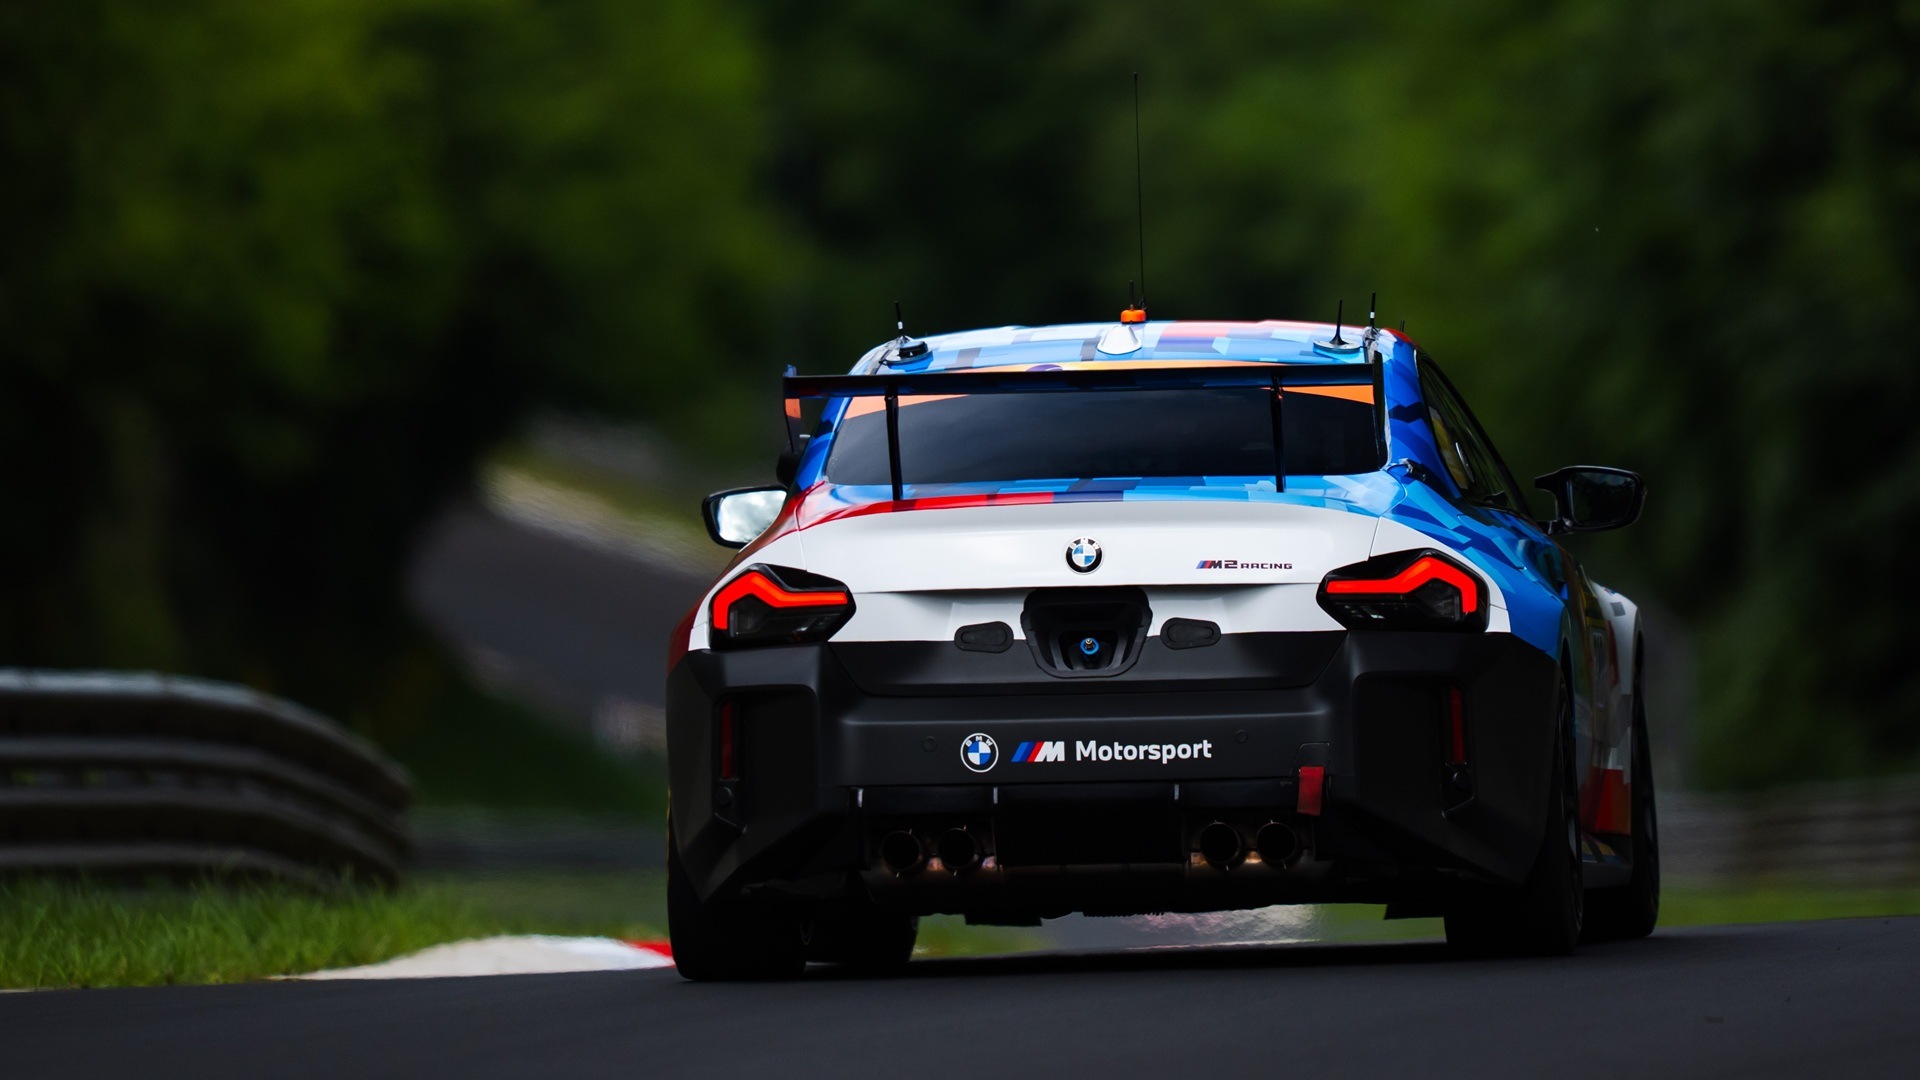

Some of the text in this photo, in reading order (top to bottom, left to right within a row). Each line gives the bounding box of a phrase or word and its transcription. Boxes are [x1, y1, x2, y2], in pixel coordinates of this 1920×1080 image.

[1069, 537, 1100, 549] BMW
[965, 735, 993, 747] BMW
[1076, 739, 1212, 764] Motorsport
